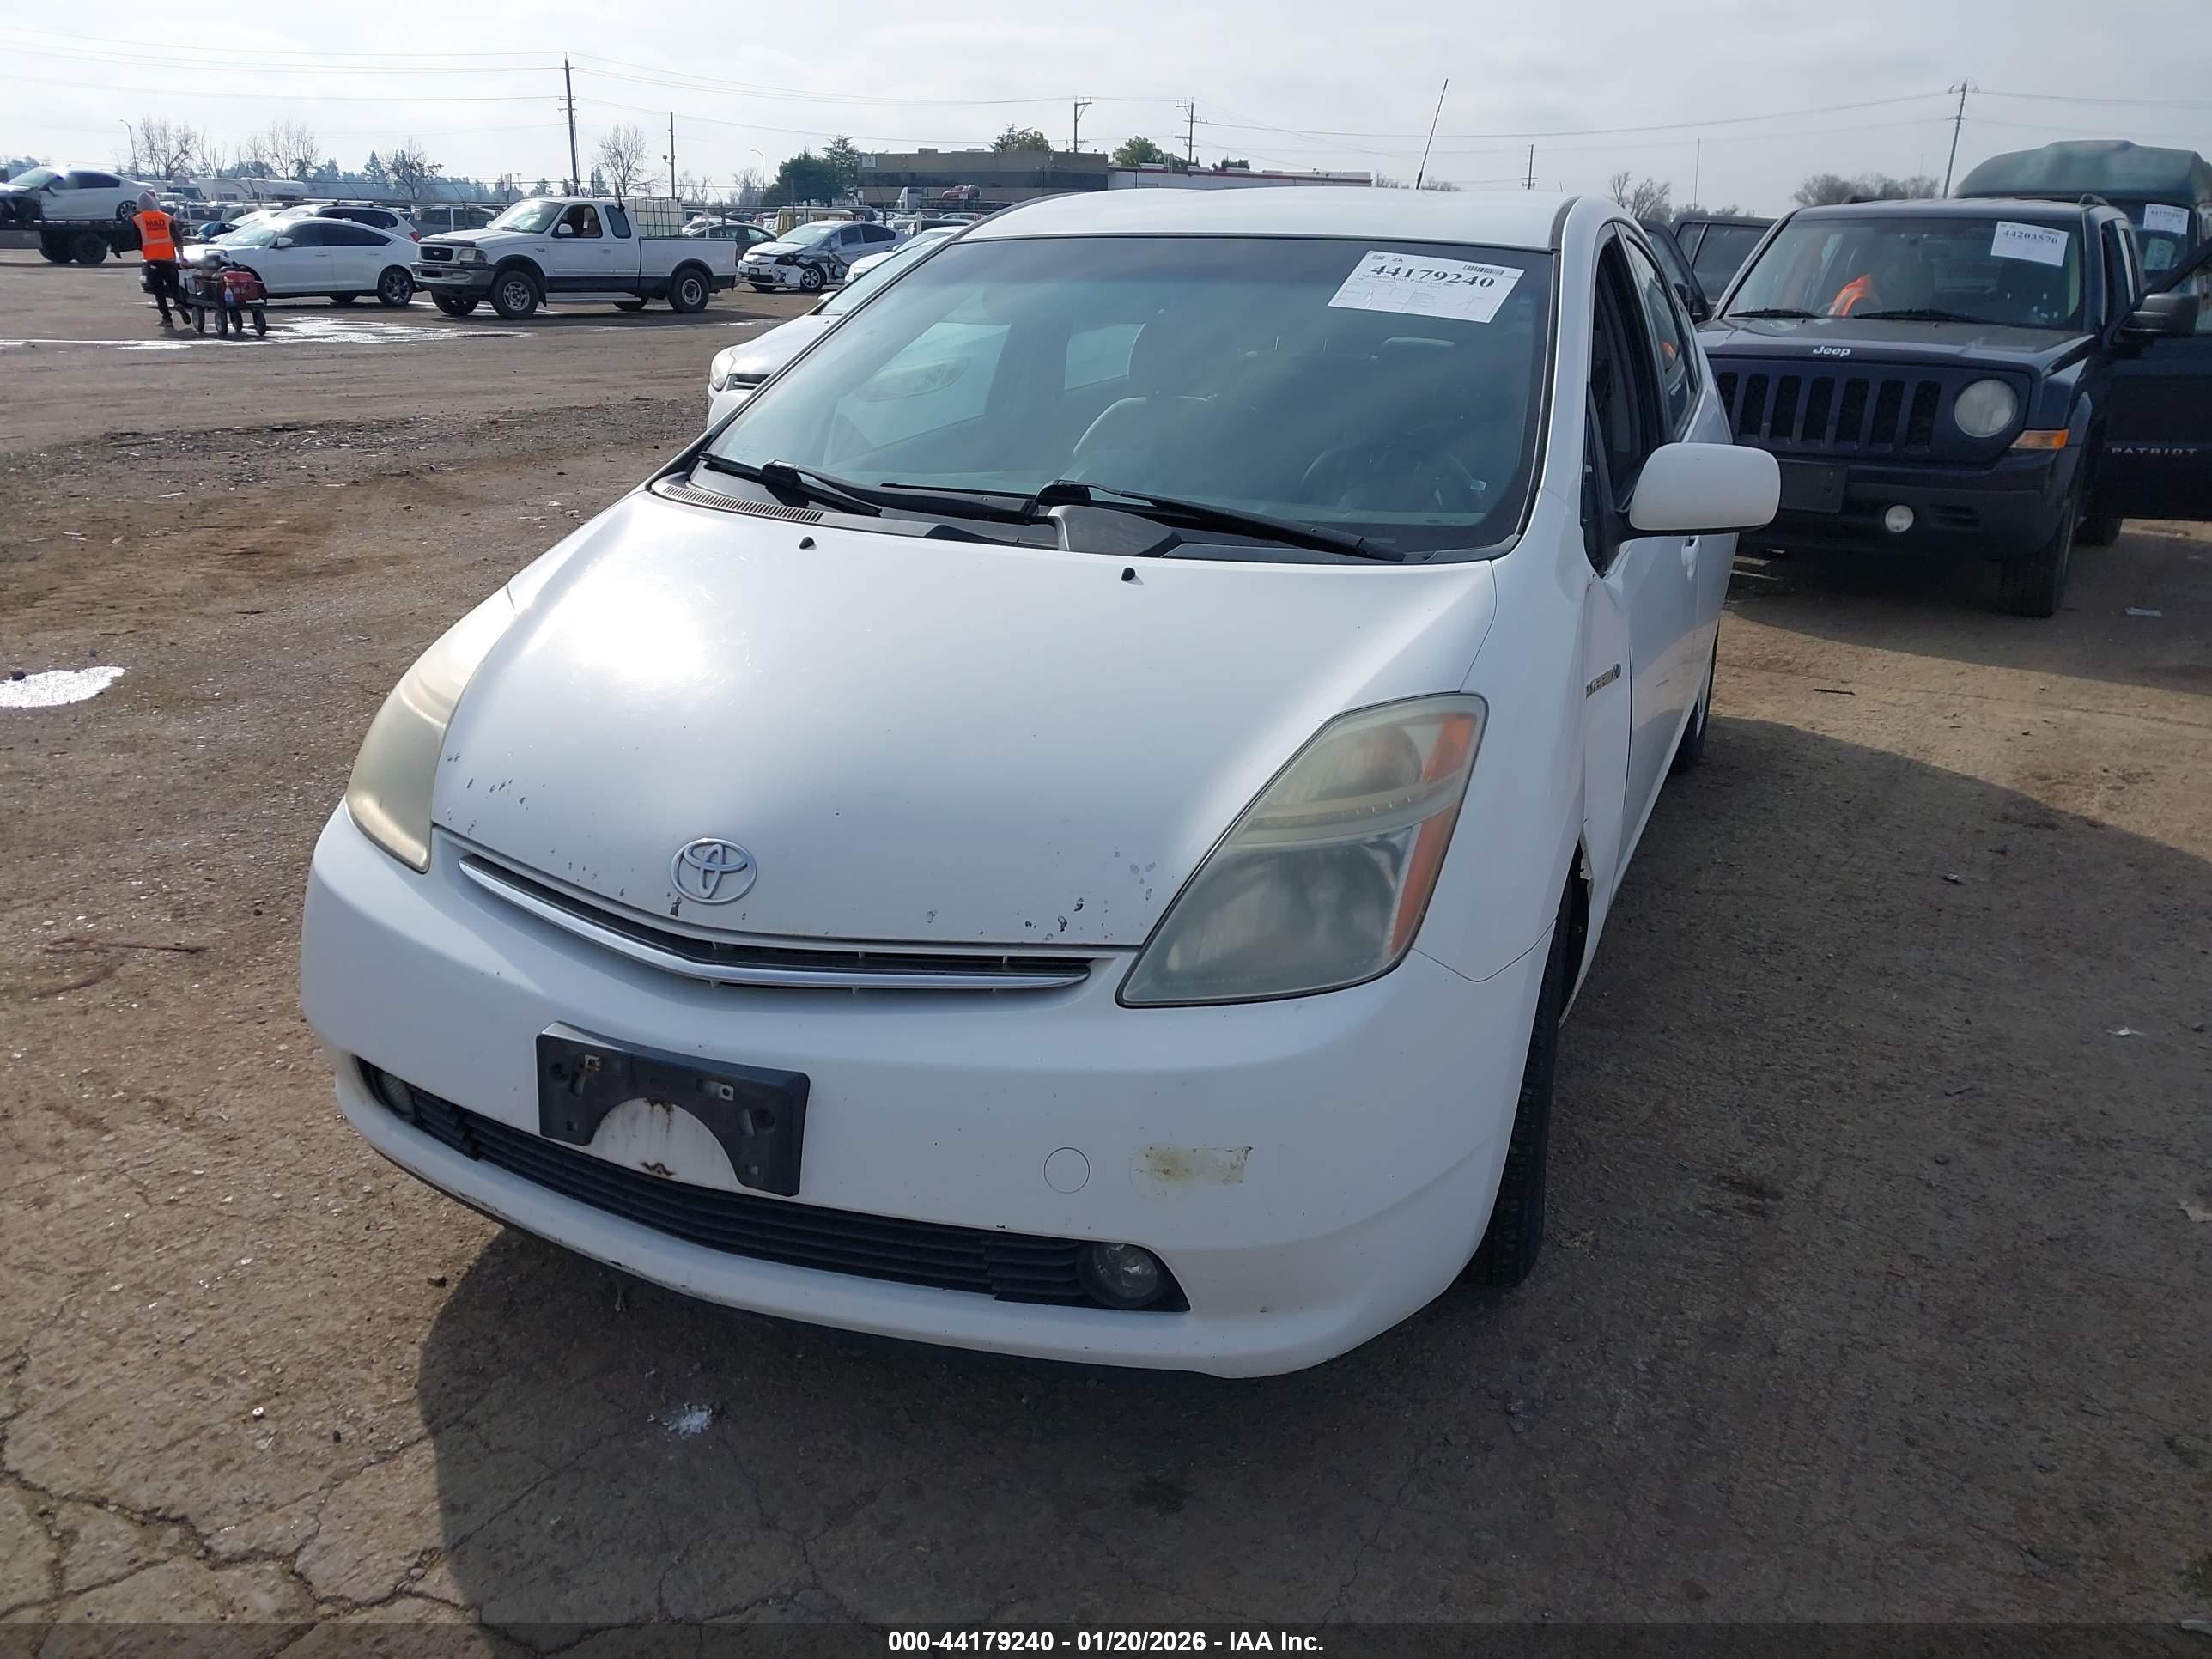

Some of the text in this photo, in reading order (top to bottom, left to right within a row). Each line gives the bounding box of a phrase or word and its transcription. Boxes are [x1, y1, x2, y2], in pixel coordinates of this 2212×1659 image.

[1370, 264, 1496, 288] 44179240
[1813, 345, 1851, 357] Jeep
[2112, 447, 2198, 456] PATRIOT
